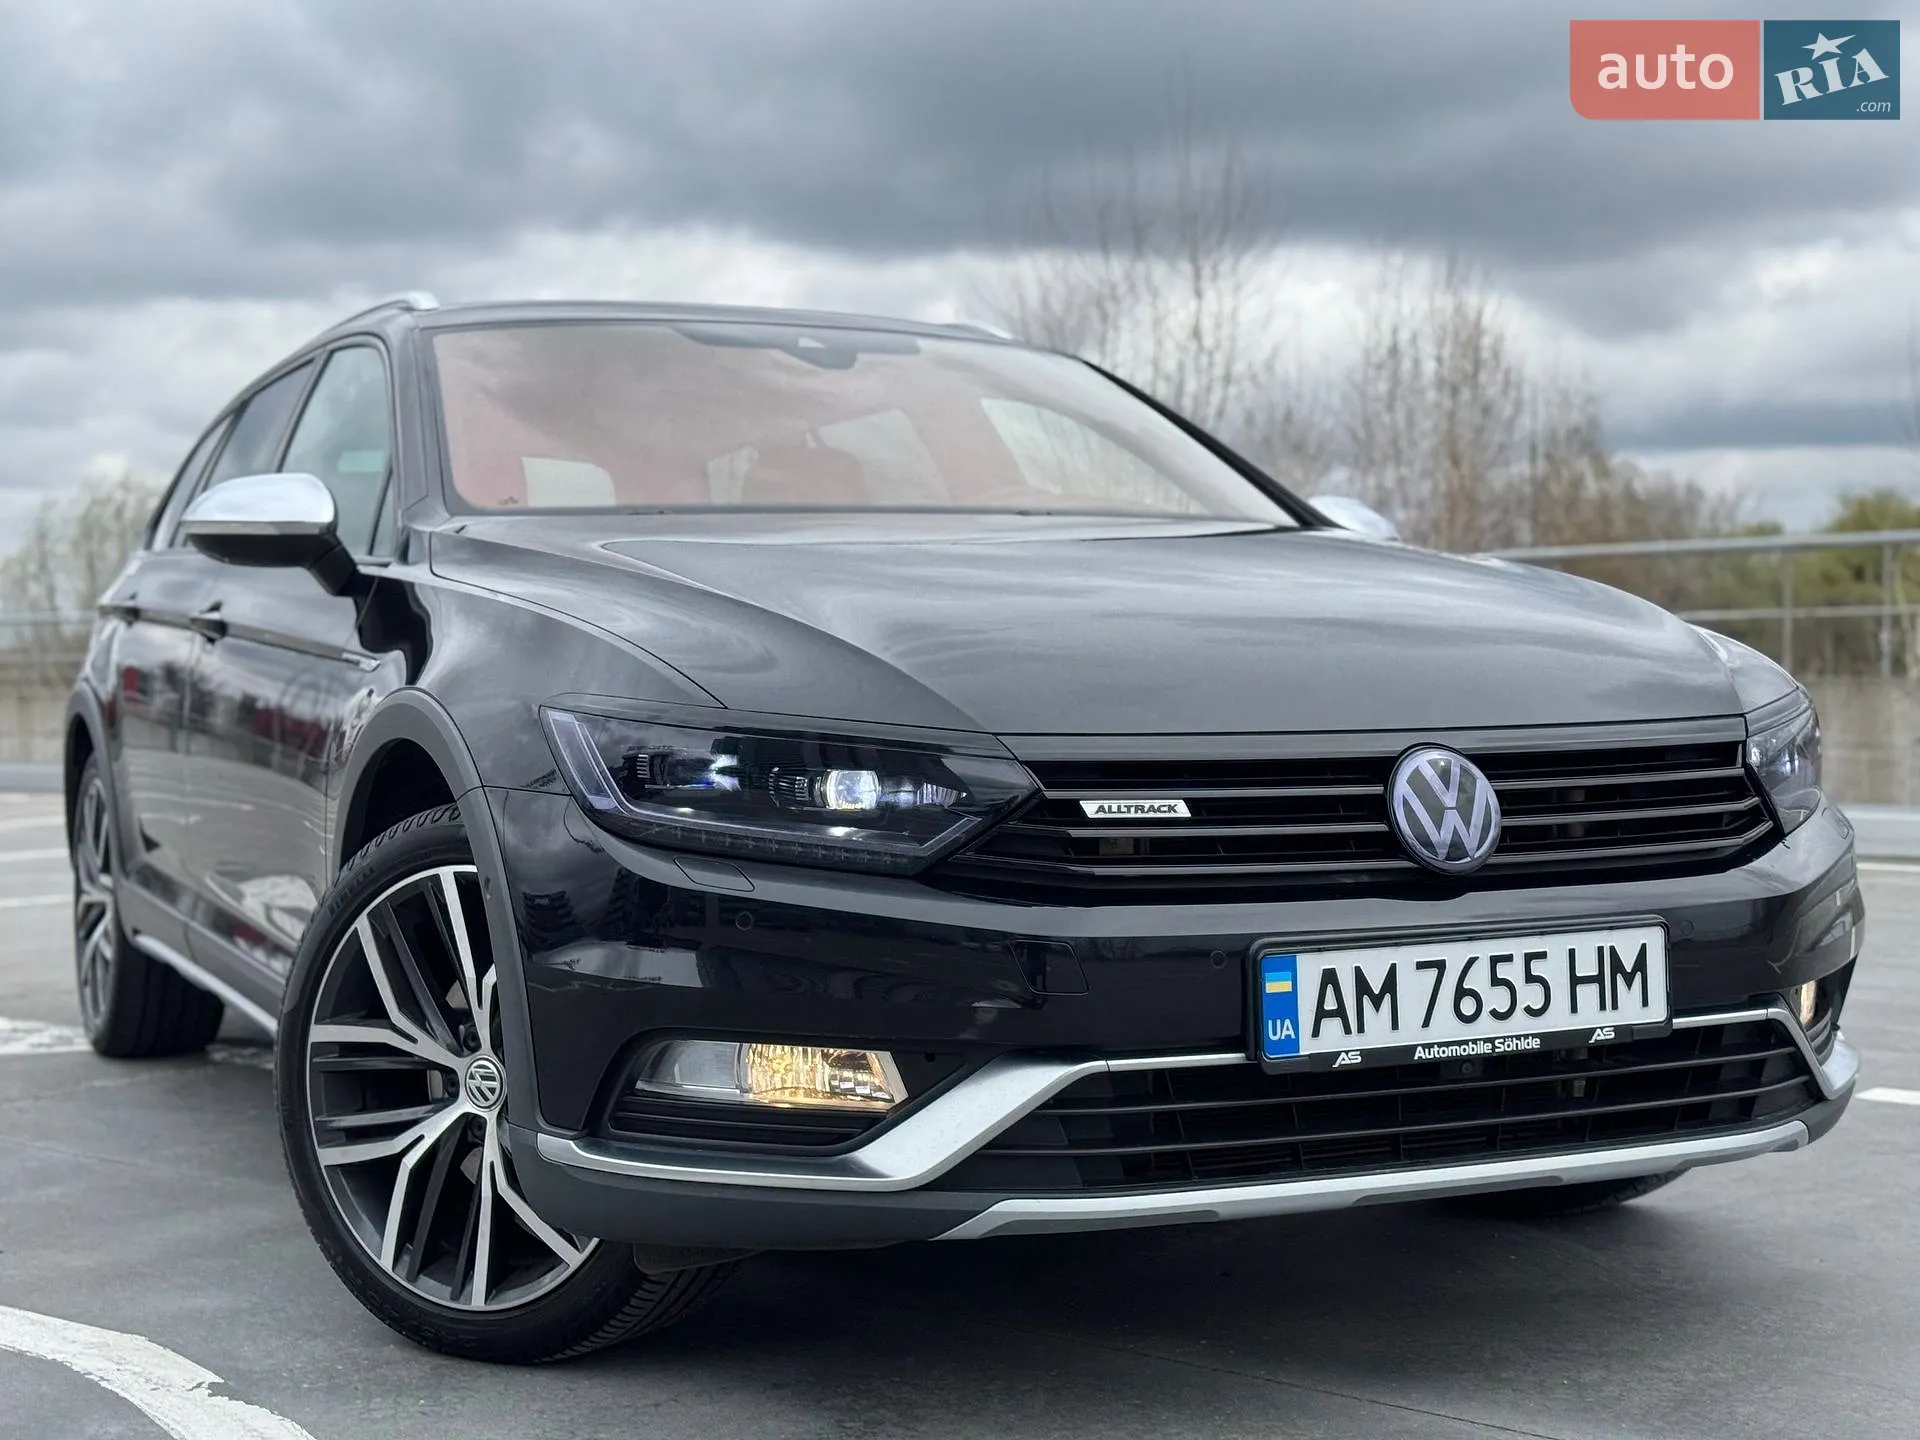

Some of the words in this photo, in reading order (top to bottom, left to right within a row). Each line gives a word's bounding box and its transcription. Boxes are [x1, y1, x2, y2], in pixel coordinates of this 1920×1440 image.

[1094, 803, 1179, 815] ALLTRACK
[1398, 752, 1498, 864] VW
[1311, 963, 1400, 1039] AM
[1415, 951, 1552, 1029] 7655
[1568, 942, 1650, 1015] HM
[1268, 1019, 1296, 1041] UA
[1332, 1051, 1362, 1068] AS
[1414, 1040, 1492, 1060] Automobile
[1494, 1036, 1541, 1053] Söhlde
[1589, 1027, 1616, 1044] AS
